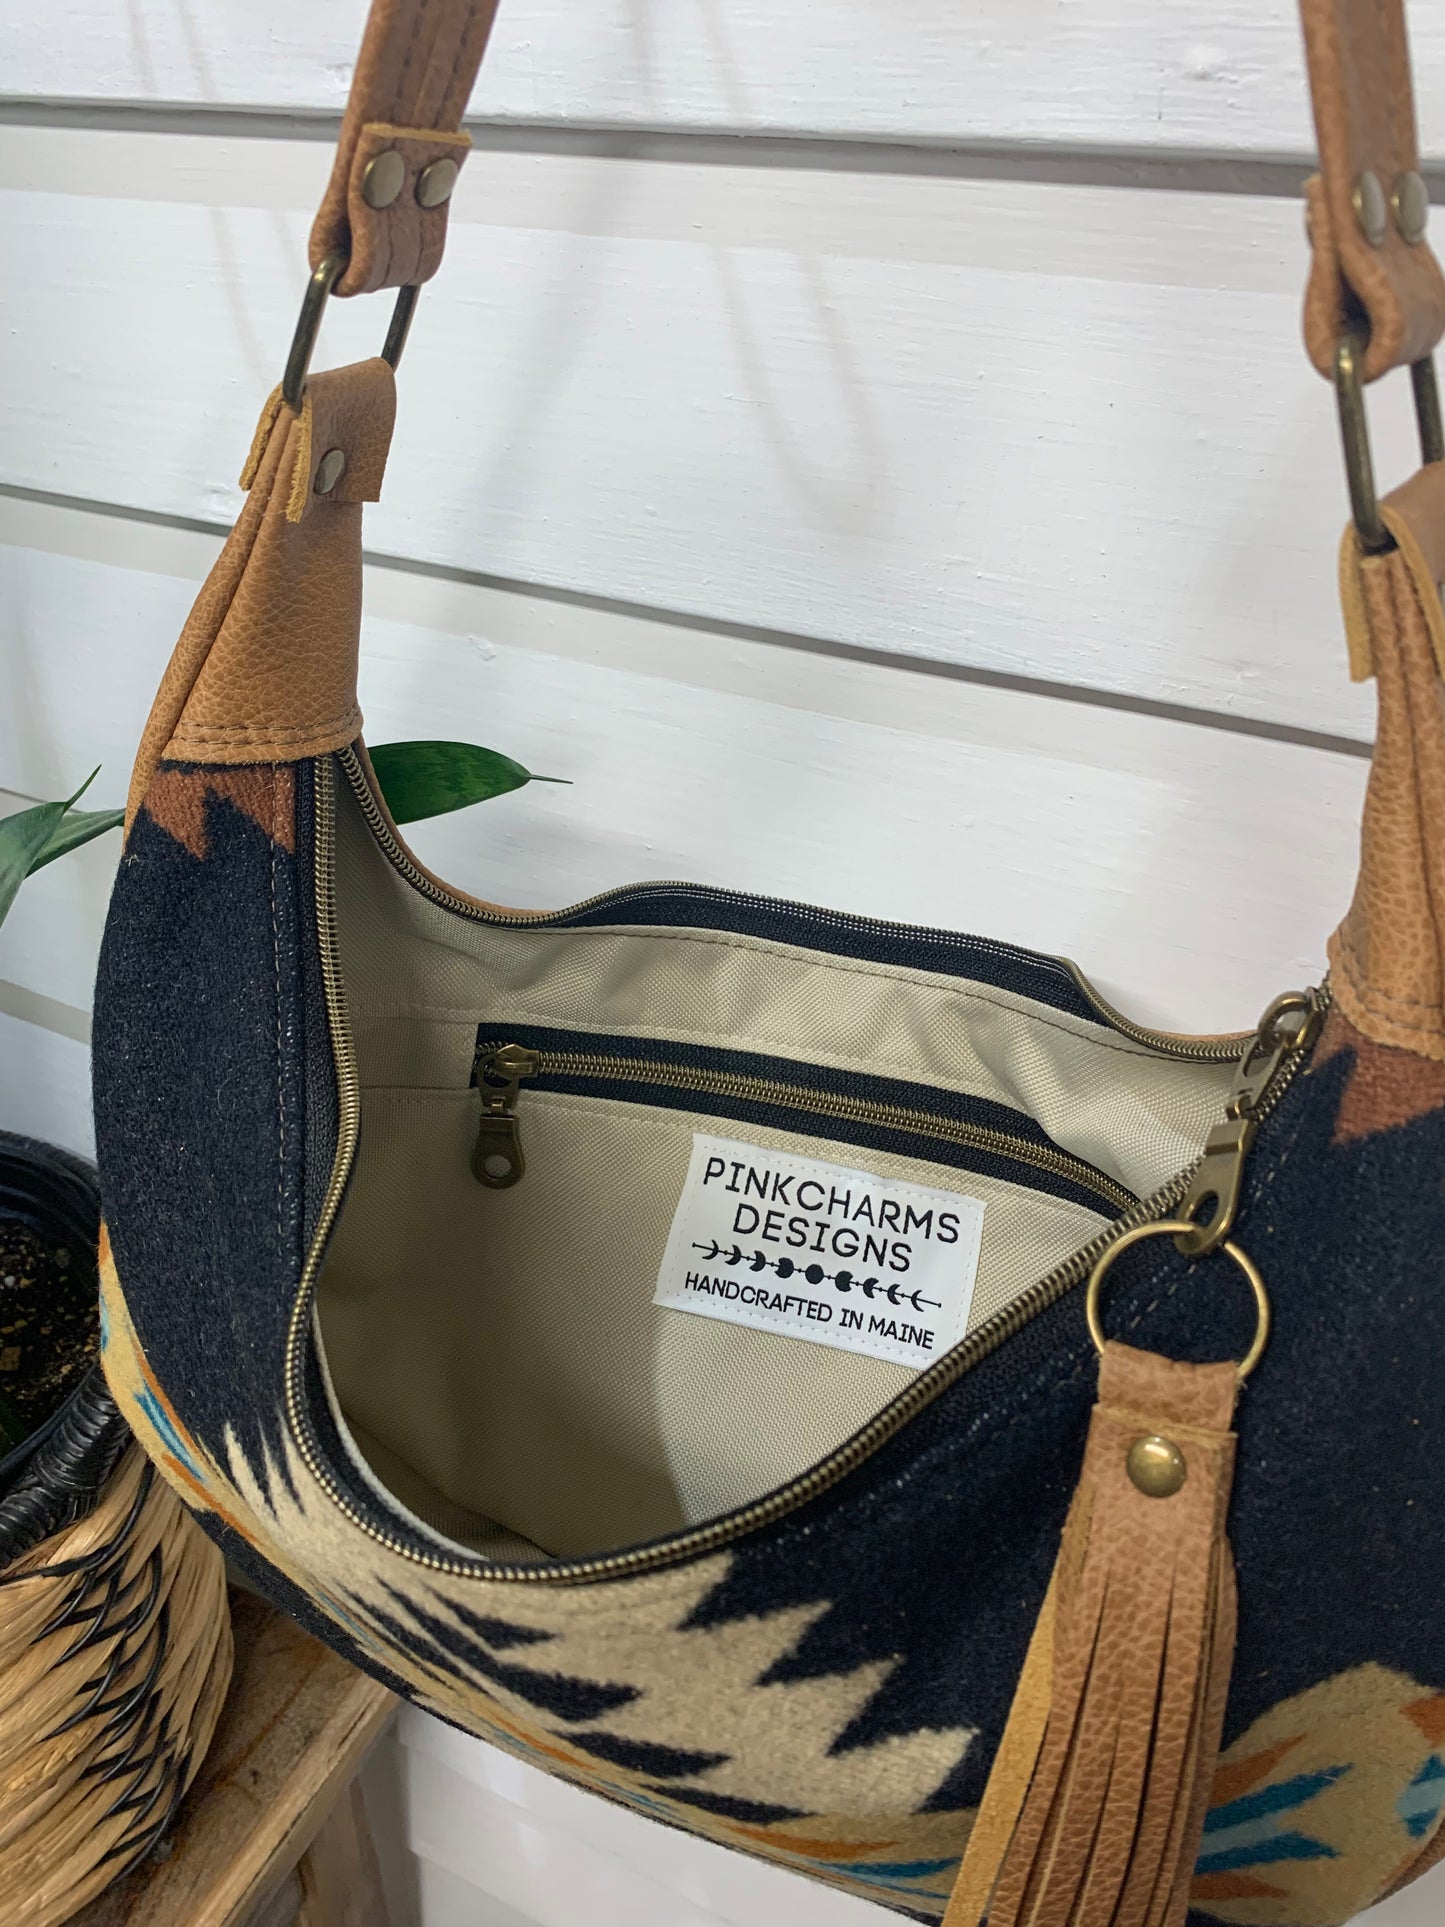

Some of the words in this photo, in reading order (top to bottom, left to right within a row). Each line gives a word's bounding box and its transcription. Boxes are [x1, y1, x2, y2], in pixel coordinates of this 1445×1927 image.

[702, 1156, 961, 1244] PINKCHARMS
[732, 1202, 913, 1273] DESIGNS
[684, 1271, 833, 1323] HANDCRAFTED
[838, 1307, 865, 1331] IN
[868, 1314, 935, 1350] MAINE
